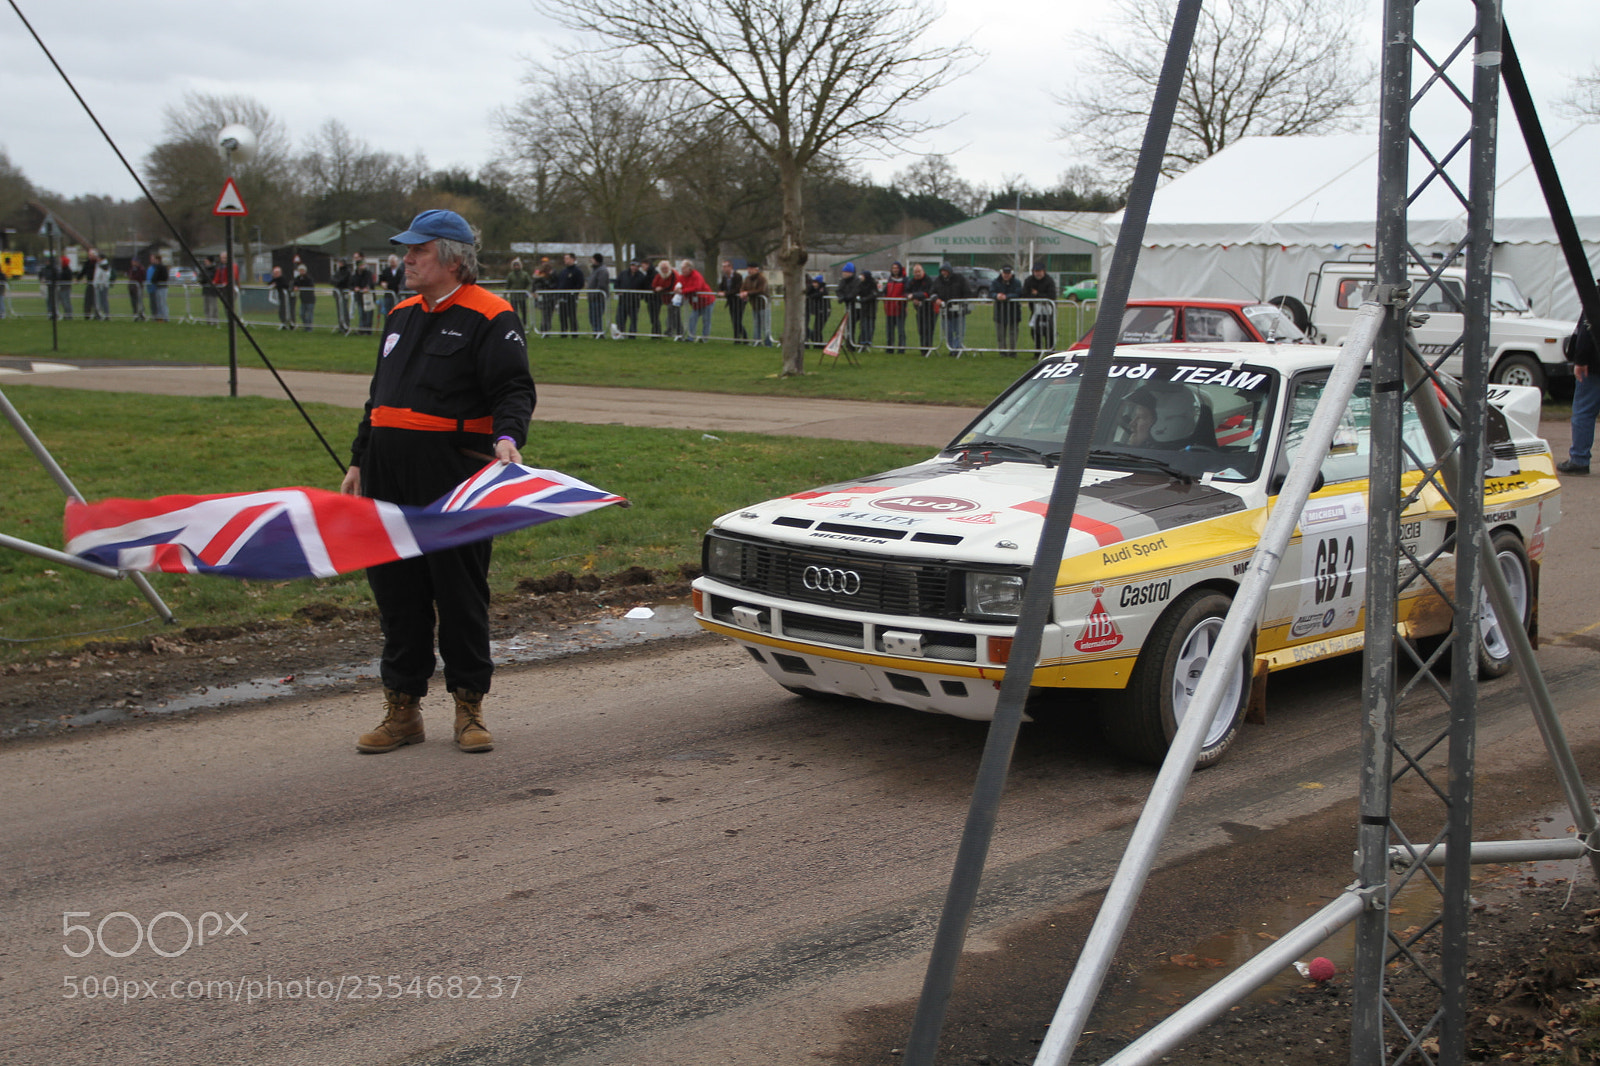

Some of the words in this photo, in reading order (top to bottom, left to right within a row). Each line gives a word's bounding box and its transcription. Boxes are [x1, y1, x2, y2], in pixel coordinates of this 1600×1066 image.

[934, 236, 949, 245] THE
[952, 236, 986, 245] KENNEL
[988, 236, 1013, 245] CLUB
[1032, 362, 1079, 380] HB
[1170, 366, 1268, 390] TEAM
[1484, 479, 1529, 496] attro
[886, 497, 968, 511] Audi
[1308, 508, 1344, 521] MICHELIN
[809, 532, 888, 545] MICHELIN
[1102, 546, 1132, 565] Audi
[1135, 537, 1168, 556] Sport
[1314, 538, 1339, 605] GB
[1341, 535, 1354, 598] 2
[1119, 578, 1173, 608] Castrol
[1085, 612, 1113, 639] HB
[1293, 641, 1327, 662] BOSCH
[1199, 728, 1238, 761] MICHELI
